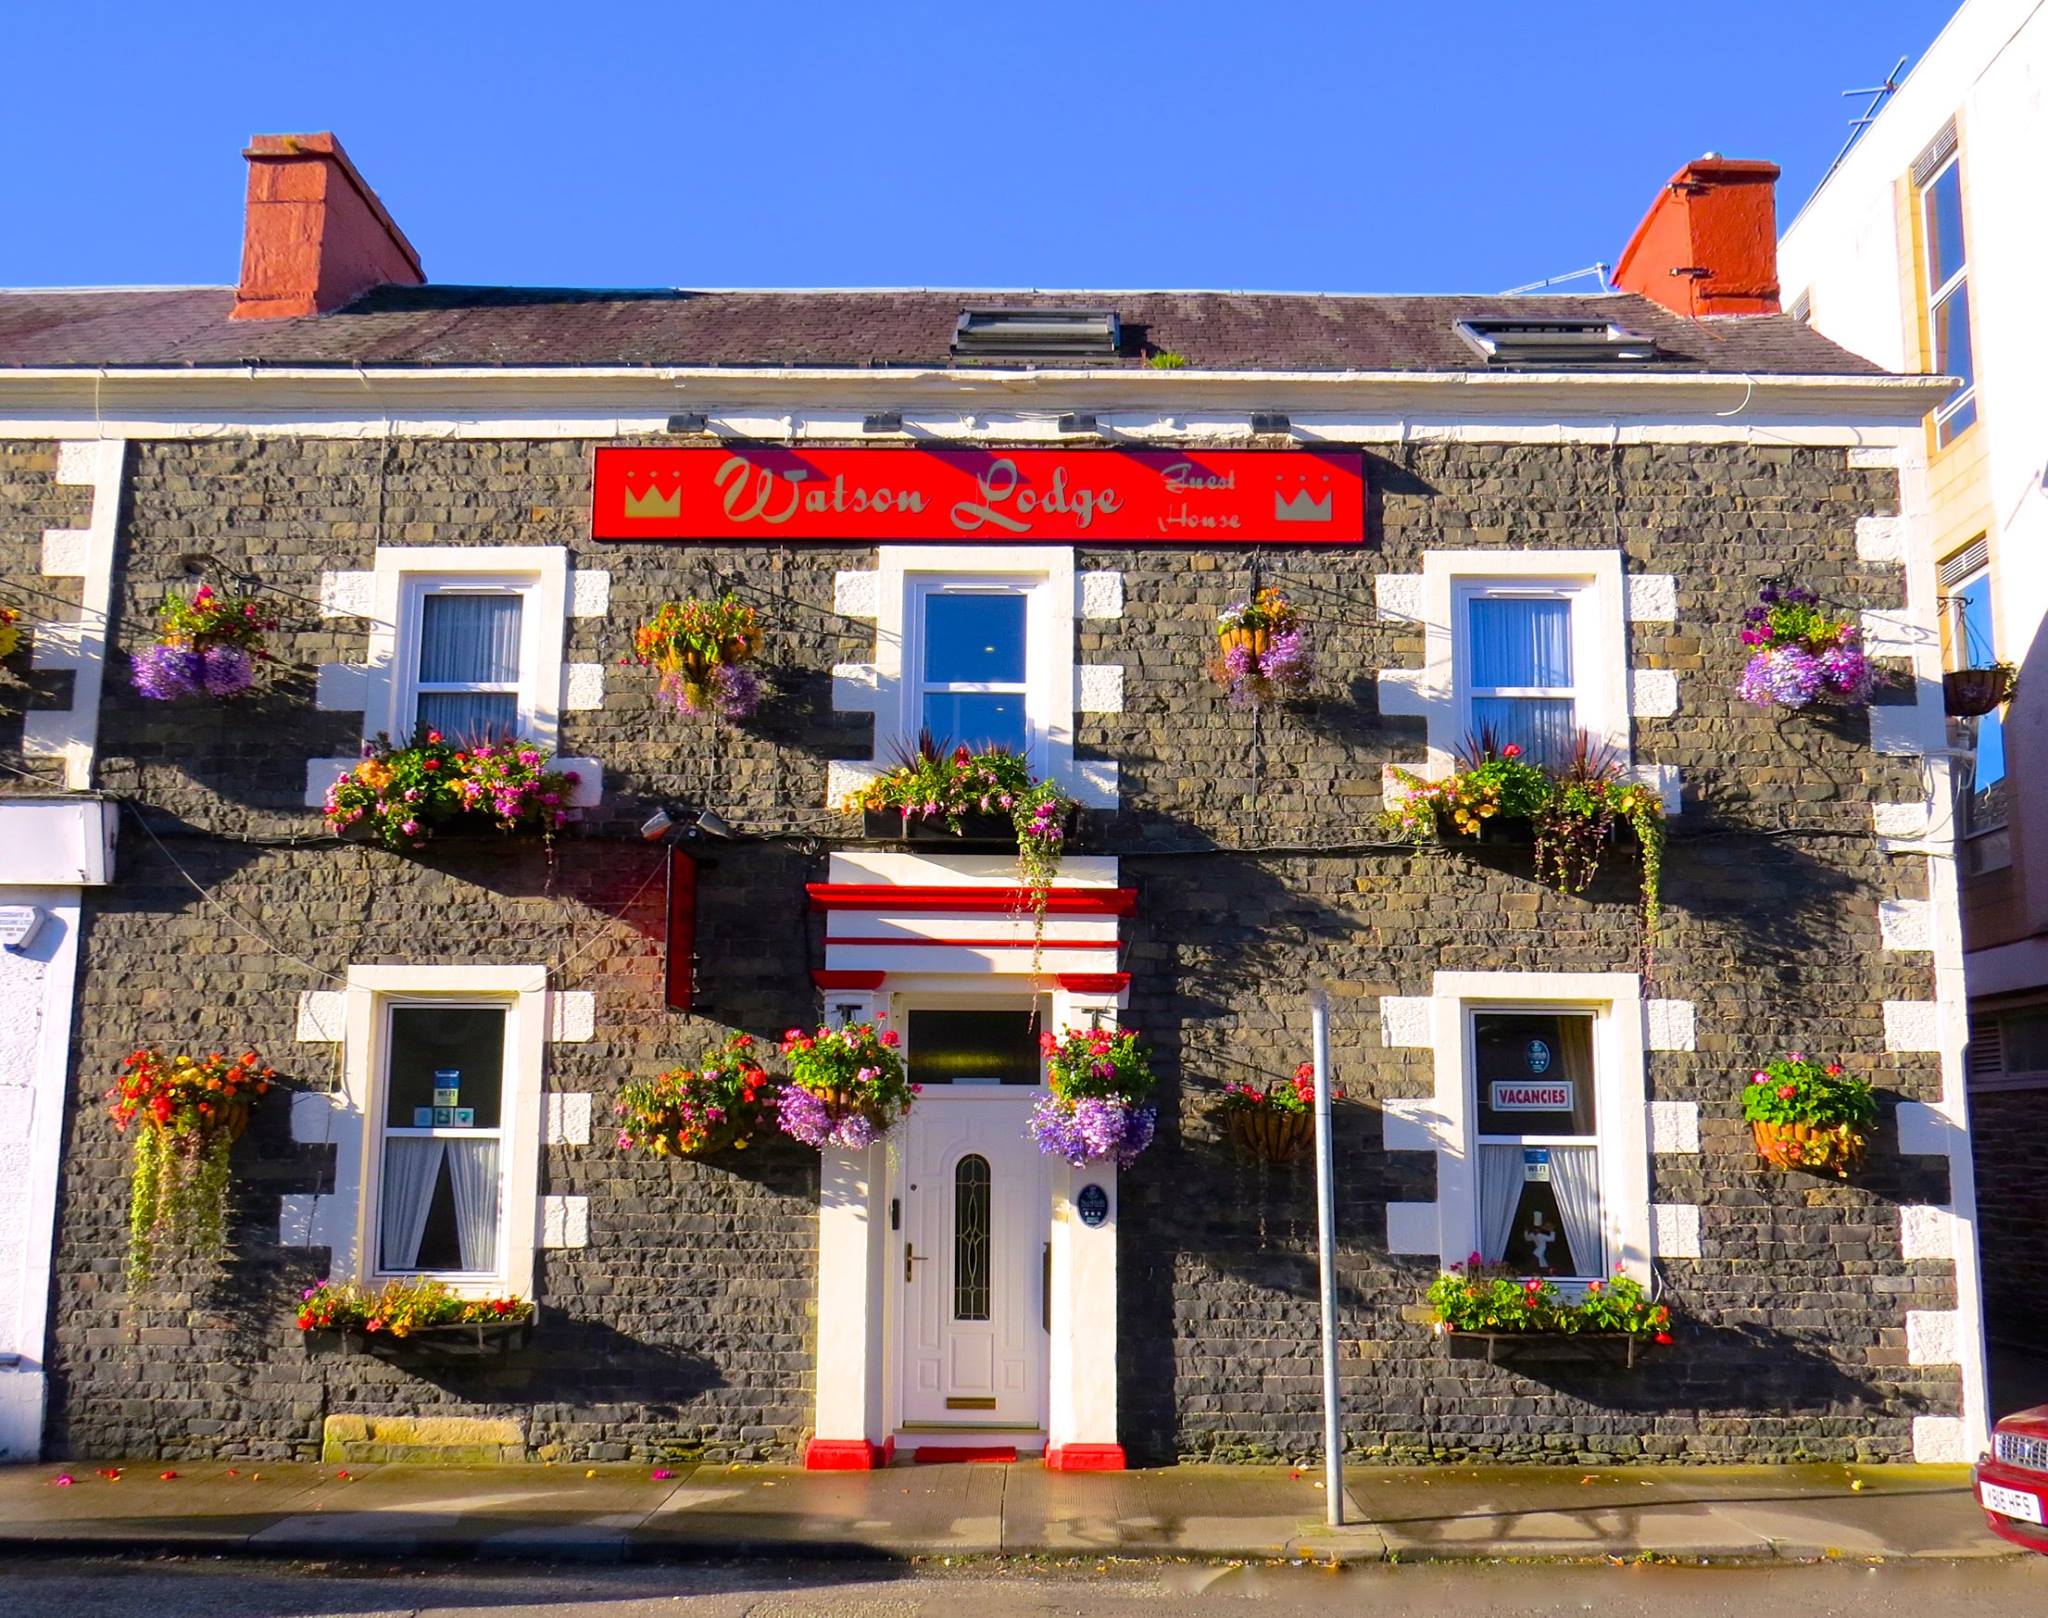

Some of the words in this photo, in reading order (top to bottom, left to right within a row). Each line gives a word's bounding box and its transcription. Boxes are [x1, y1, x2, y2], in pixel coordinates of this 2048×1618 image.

[1160, 463, 1236, 494] Guest
[714, 456, 931, 524] Watson
[950, 458, 1124, 533] Lodge
[1157, 502, 1242, 532] House
[1499, 1089, 1566, 1104] VACANCIES
